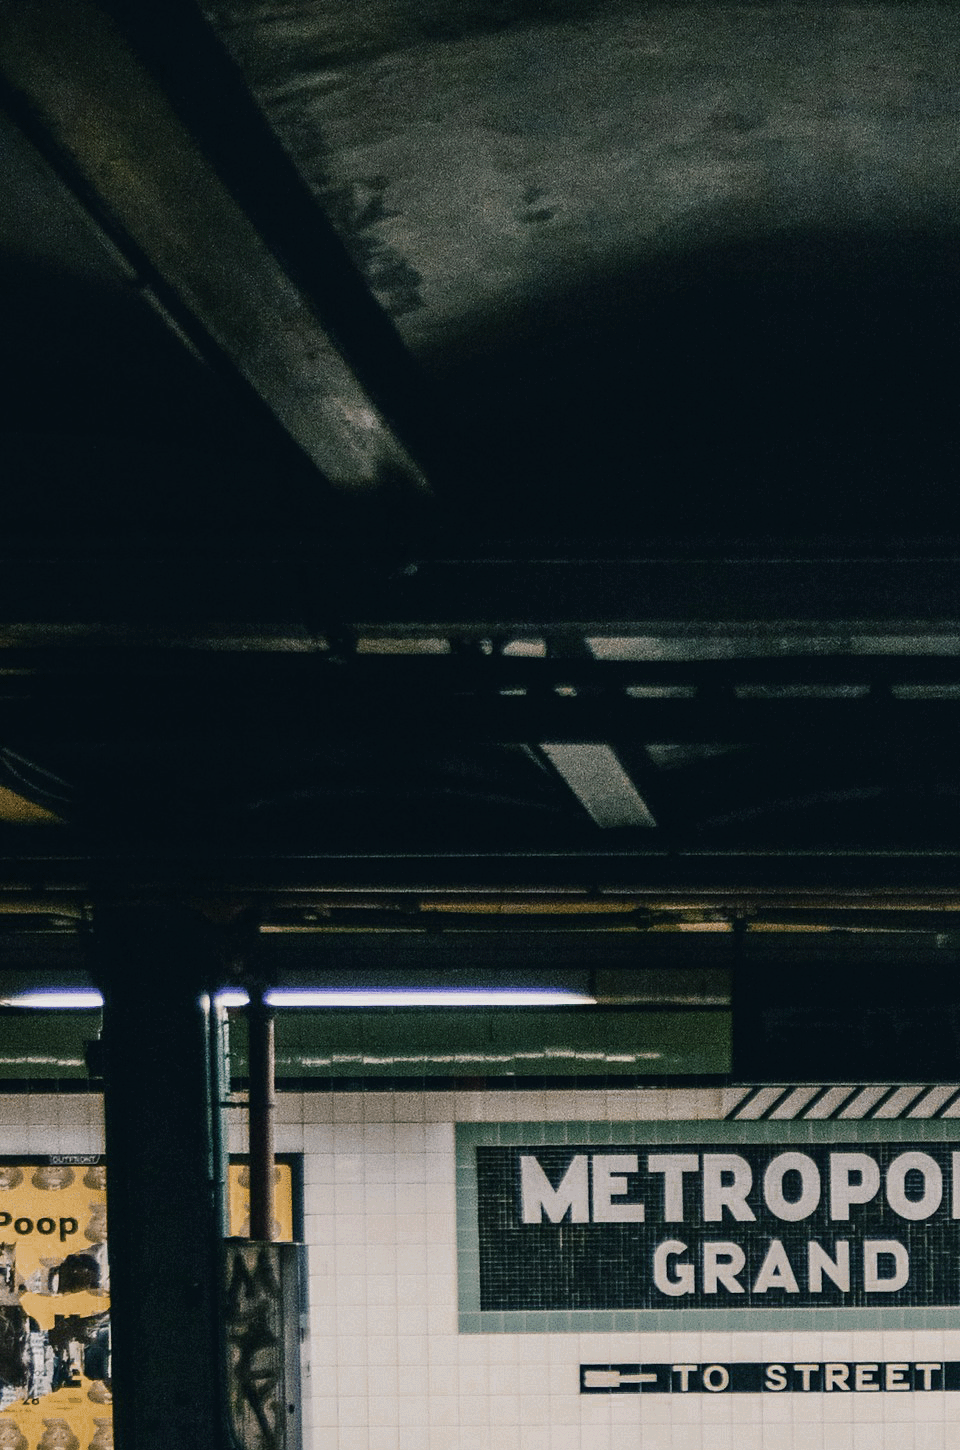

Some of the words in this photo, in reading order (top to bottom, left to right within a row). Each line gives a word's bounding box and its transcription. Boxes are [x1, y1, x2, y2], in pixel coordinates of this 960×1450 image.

[653, 1239, 910, 1297] GRAND
[672, 1365, 730, 1391] TO
[765, 1363, 941, 1391] STREET
